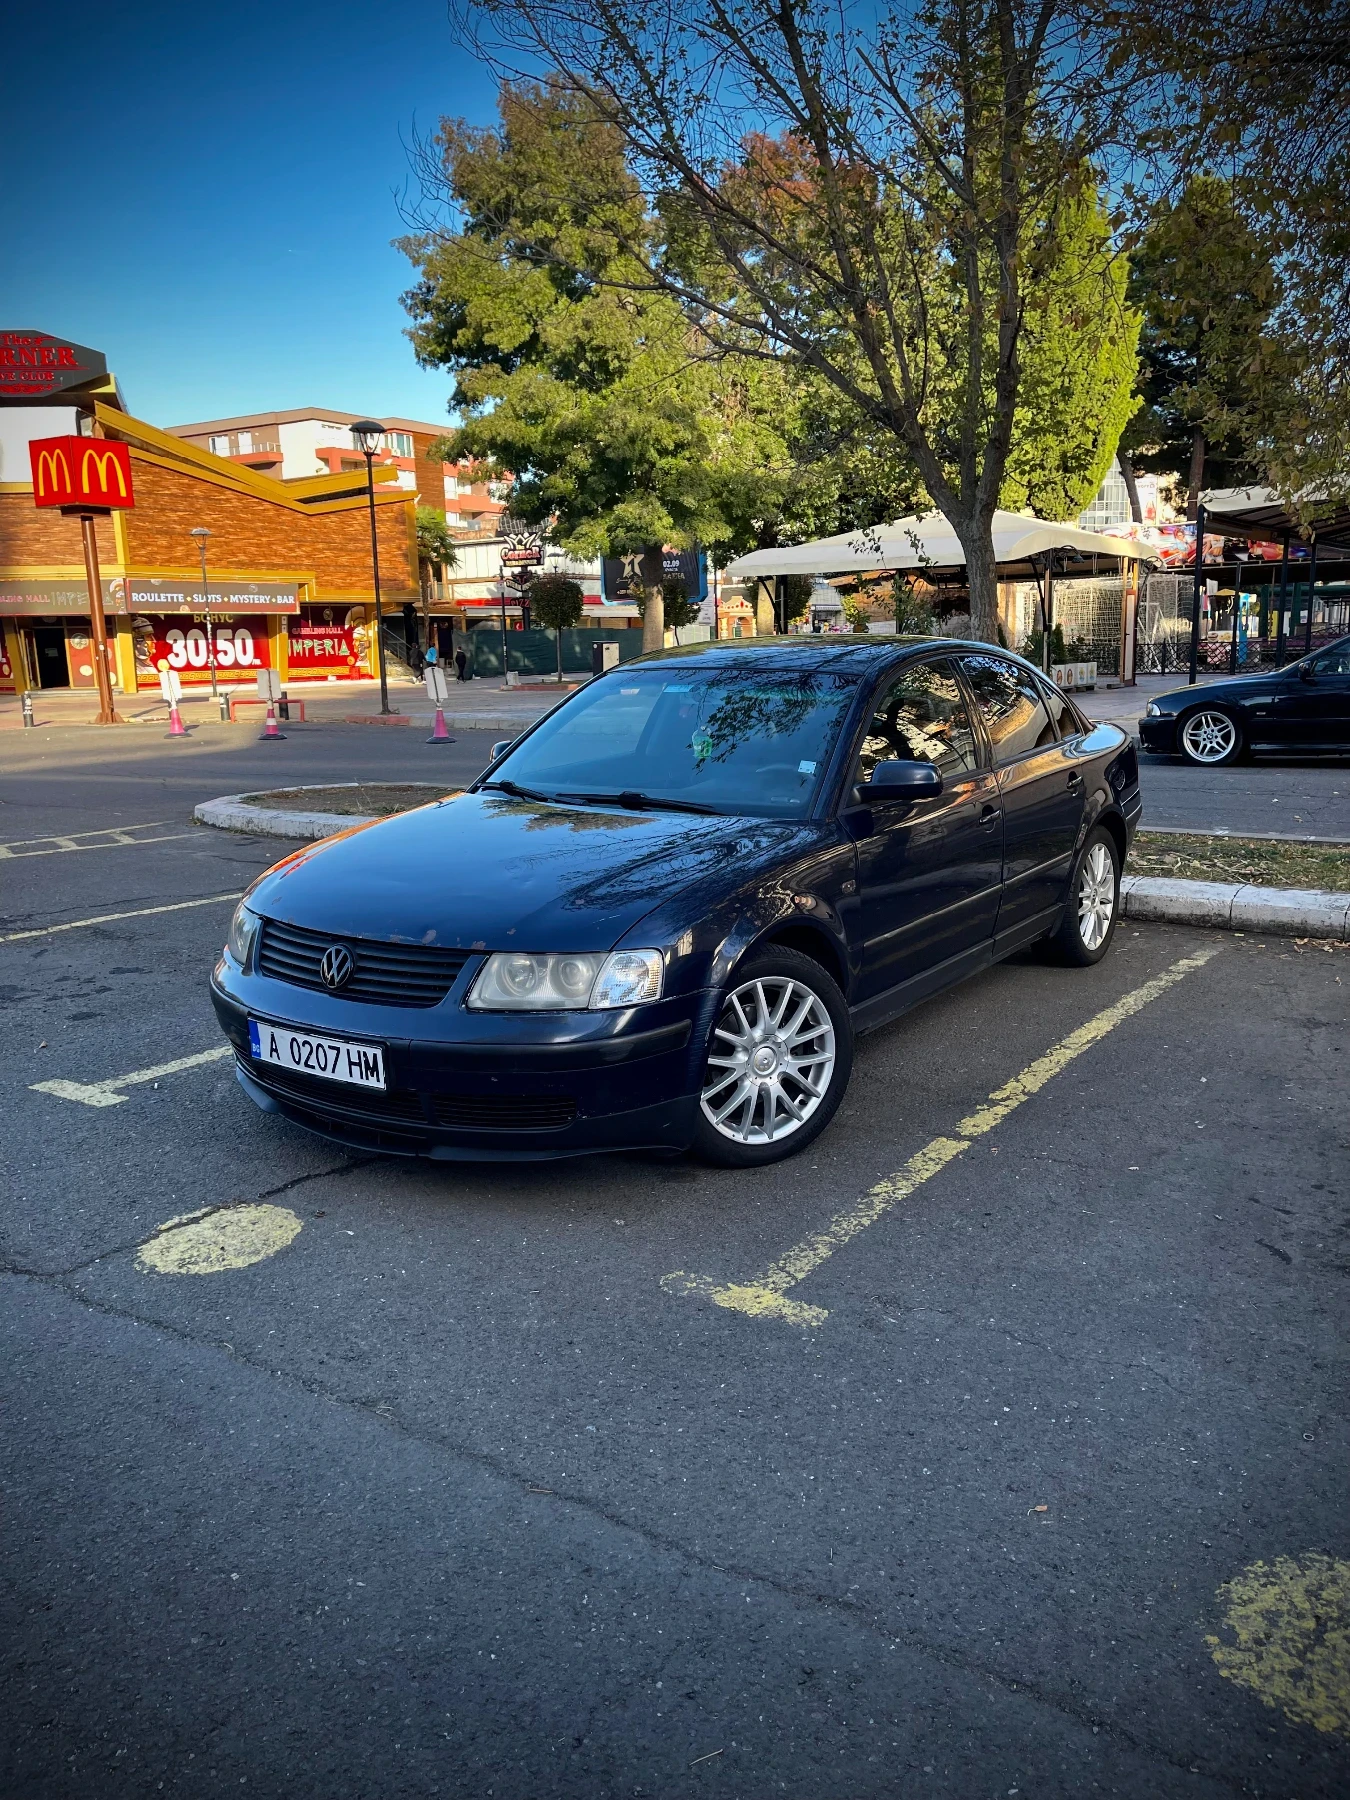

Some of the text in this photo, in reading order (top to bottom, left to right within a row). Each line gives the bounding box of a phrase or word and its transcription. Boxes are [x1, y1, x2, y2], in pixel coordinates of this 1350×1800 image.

[2, 333, 31, 346] The
[19, 371, 55, 381] CLUB
[662, 560, 680, 569] 02.09
[26, 595, 50, 603] HALL
[51, 591, 114, 606] IMPEA
[131, 592, 184, 602] ROULETTE
[229, 595, 270, 604] MYSTERY
[277, 595, 295, 604] BAR
[165, 628, 207, 668] 30
[216, 628, 254, 667] 50
[288, 638, 350, 657] IMPERIA
[269, 1031, 381, 1082] A 0207 HM
